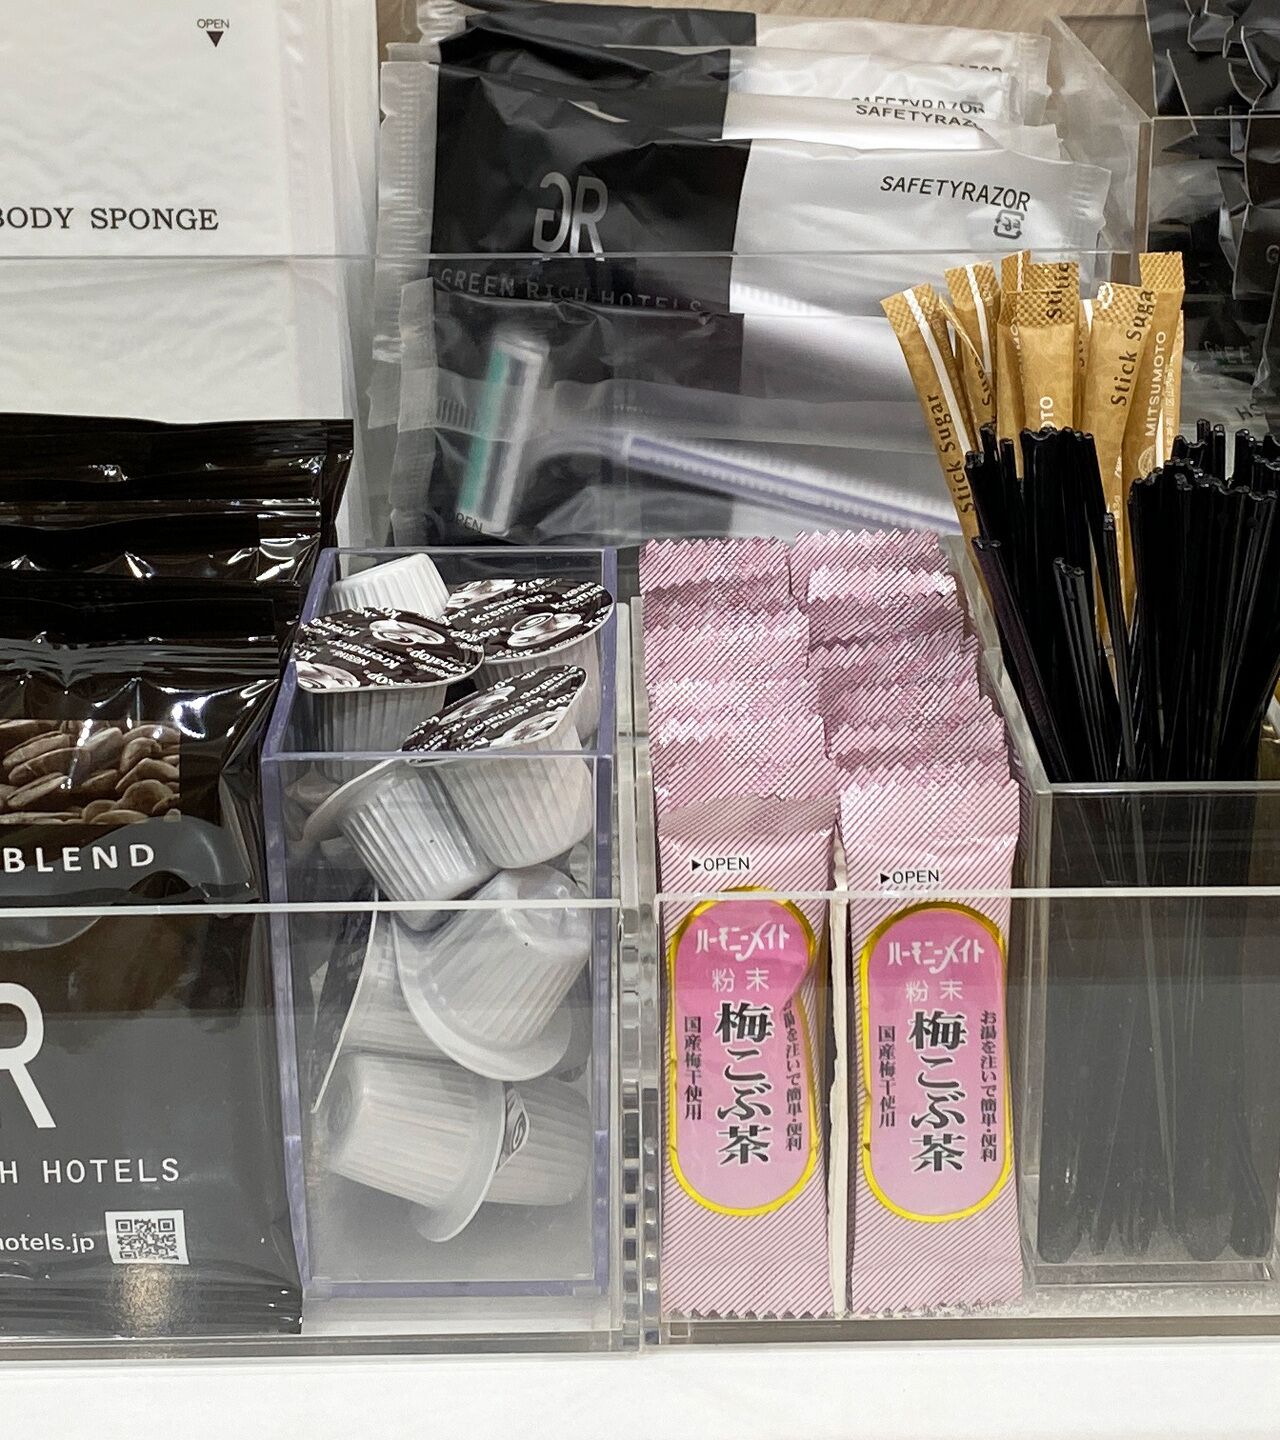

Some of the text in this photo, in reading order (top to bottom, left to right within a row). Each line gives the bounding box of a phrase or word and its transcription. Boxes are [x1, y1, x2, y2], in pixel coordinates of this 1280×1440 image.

[196, 18, 230, 29] OPEN
[880, 175, 1032, 212] SAFETYRAZOR
[89, 206, 220, 232] SPONGE
[440, 267, 516, 297] GREEN
[1111, 348, 1139, 407] Stick
[1144, 331, 1167, 438] MITSUMOTO
[926, 394, 956, 454] Sugar
[946, 459, 977, 515] Stick
[3, 843, 156, 874] BLEND
[703, 857, 751, 872] OPEN
[892, 869, 940, 884] OPEN
[683, 1015, 703, 1121] 国産梅干使用
[715, 1001, 773, 1166] 梅こぶ茶
[877, 1024, 896, 1129] 国産梅干使用
[908, 1009, 967, 1173] 梅こぶ茶
[41, 1156, 181, 1185] HOTELS
